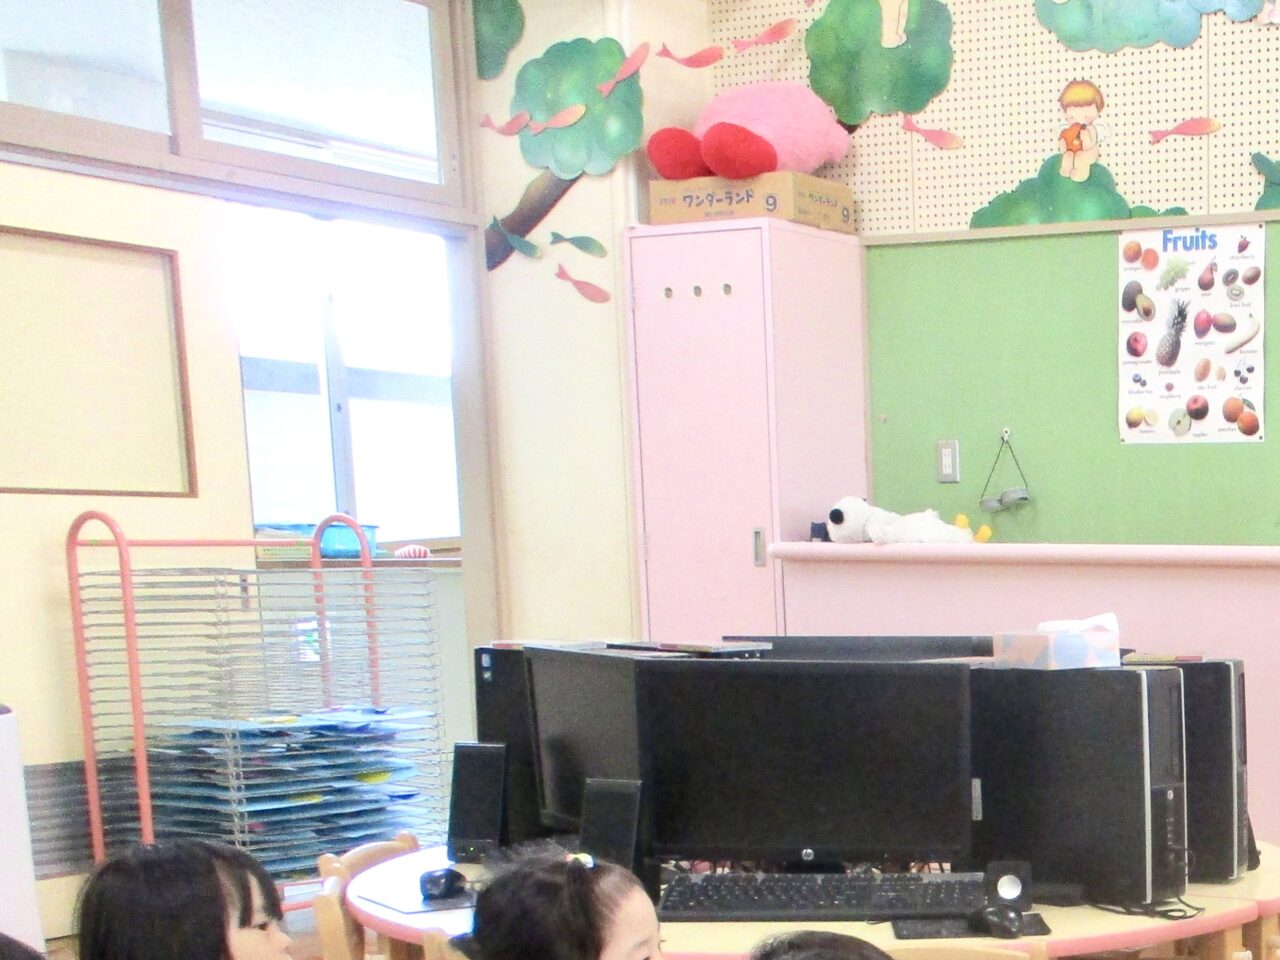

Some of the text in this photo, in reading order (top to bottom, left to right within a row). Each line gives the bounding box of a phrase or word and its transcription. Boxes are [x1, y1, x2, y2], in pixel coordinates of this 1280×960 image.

[683, 189, 754, 208] ワンダーランド
[765, 194, 778, 212] 9
[842, 207, 850, 223] 9
[1162, 226, 1218, 253] Fruits
